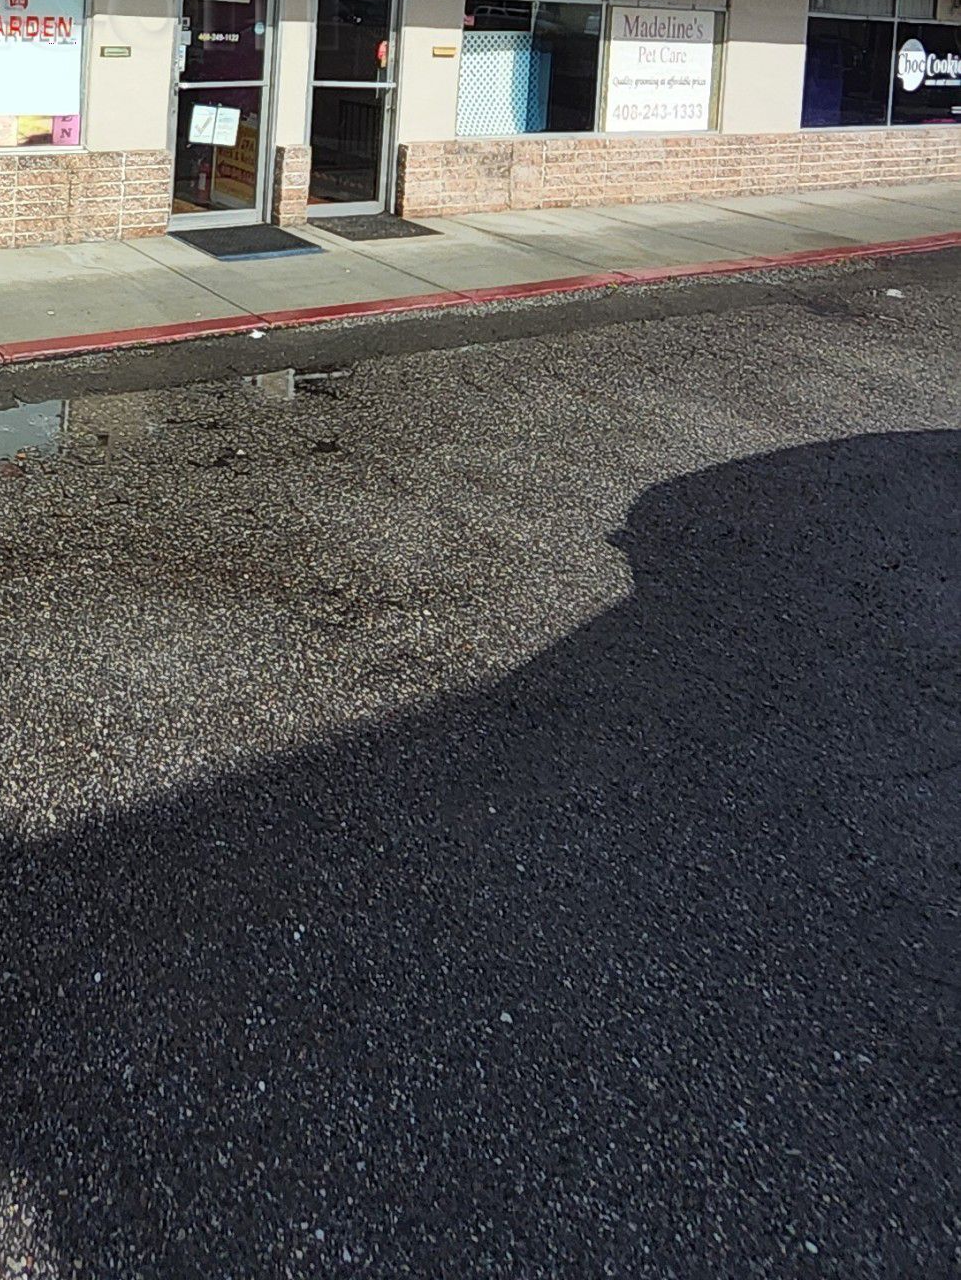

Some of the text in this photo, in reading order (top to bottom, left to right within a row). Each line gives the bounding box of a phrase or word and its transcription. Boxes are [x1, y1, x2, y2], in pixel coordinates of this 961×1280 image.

[623, 13, 704, 39] Madeline's
[638, 46, 687, 64] Pet Care
[897, 53, 926, 77] Choc
[612, 103, 704, 121] 408-243-1333
